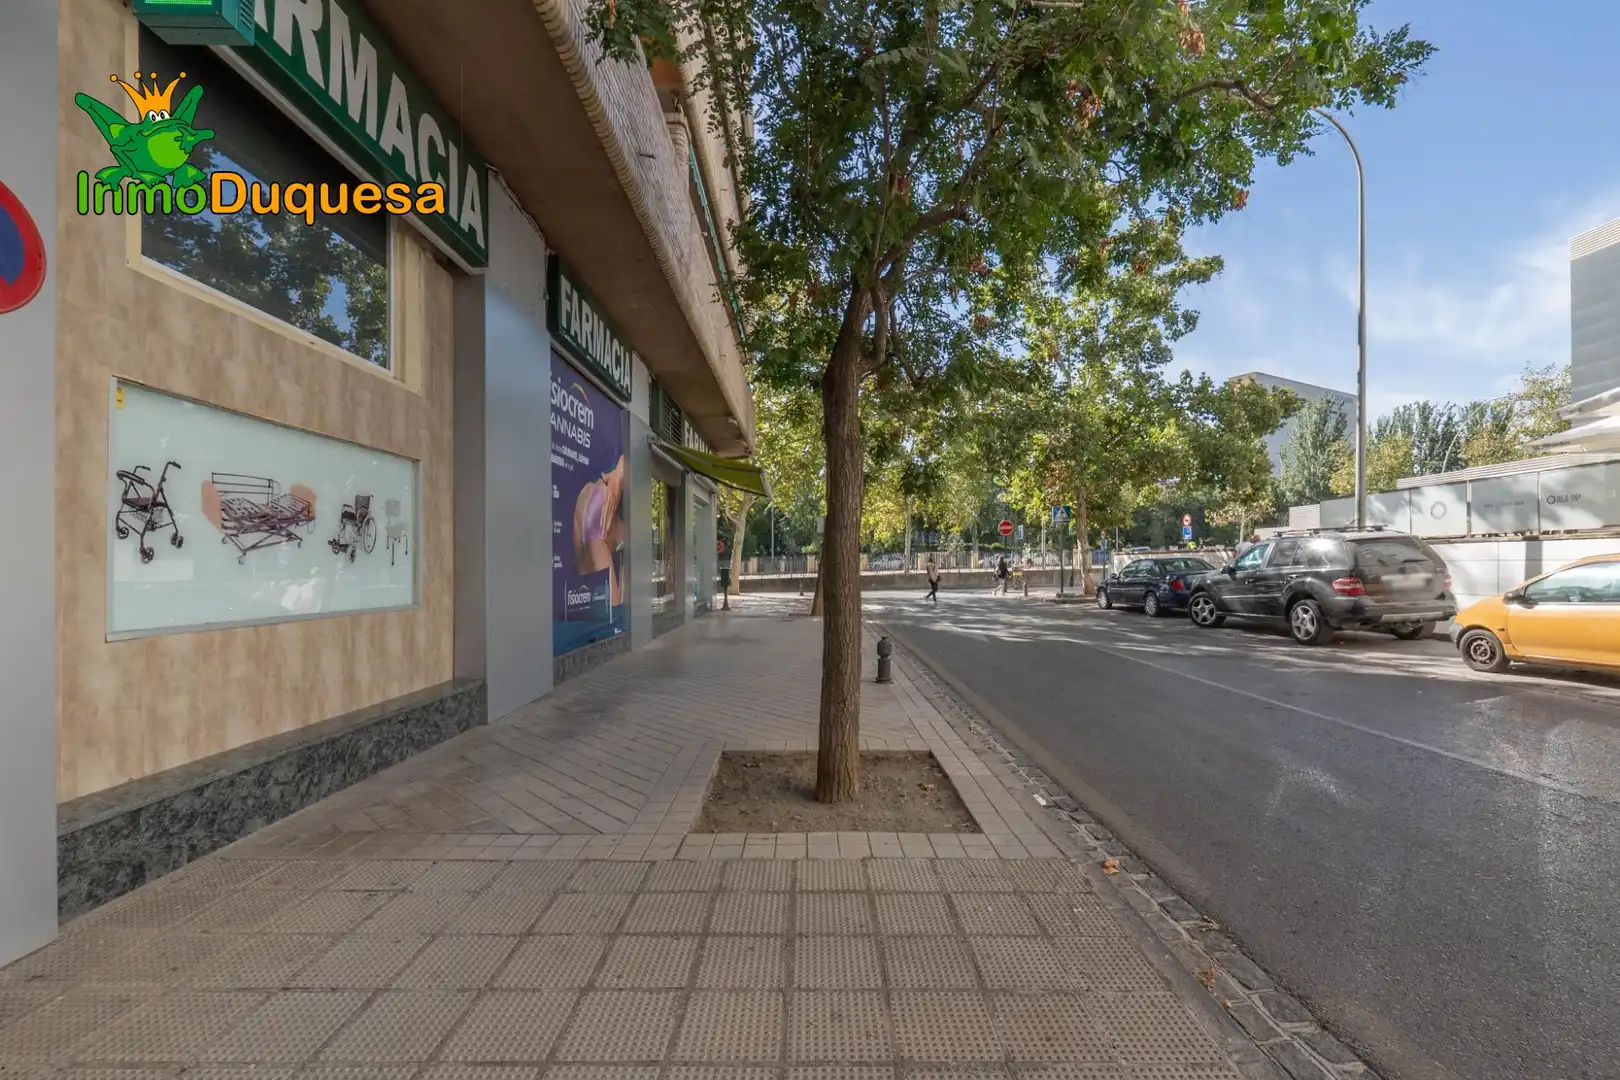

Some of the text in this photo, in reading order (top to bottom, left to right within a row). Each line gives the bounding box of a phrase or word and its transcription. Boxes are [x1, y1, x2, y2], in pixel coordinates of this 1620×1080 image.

[254, 0, 485, 250] RMACIA
[560, 274, 632, 394] FARMACIA
[550, 411, 592, 449] ANNABIS
[551, 376, 594, 430] siocrem
